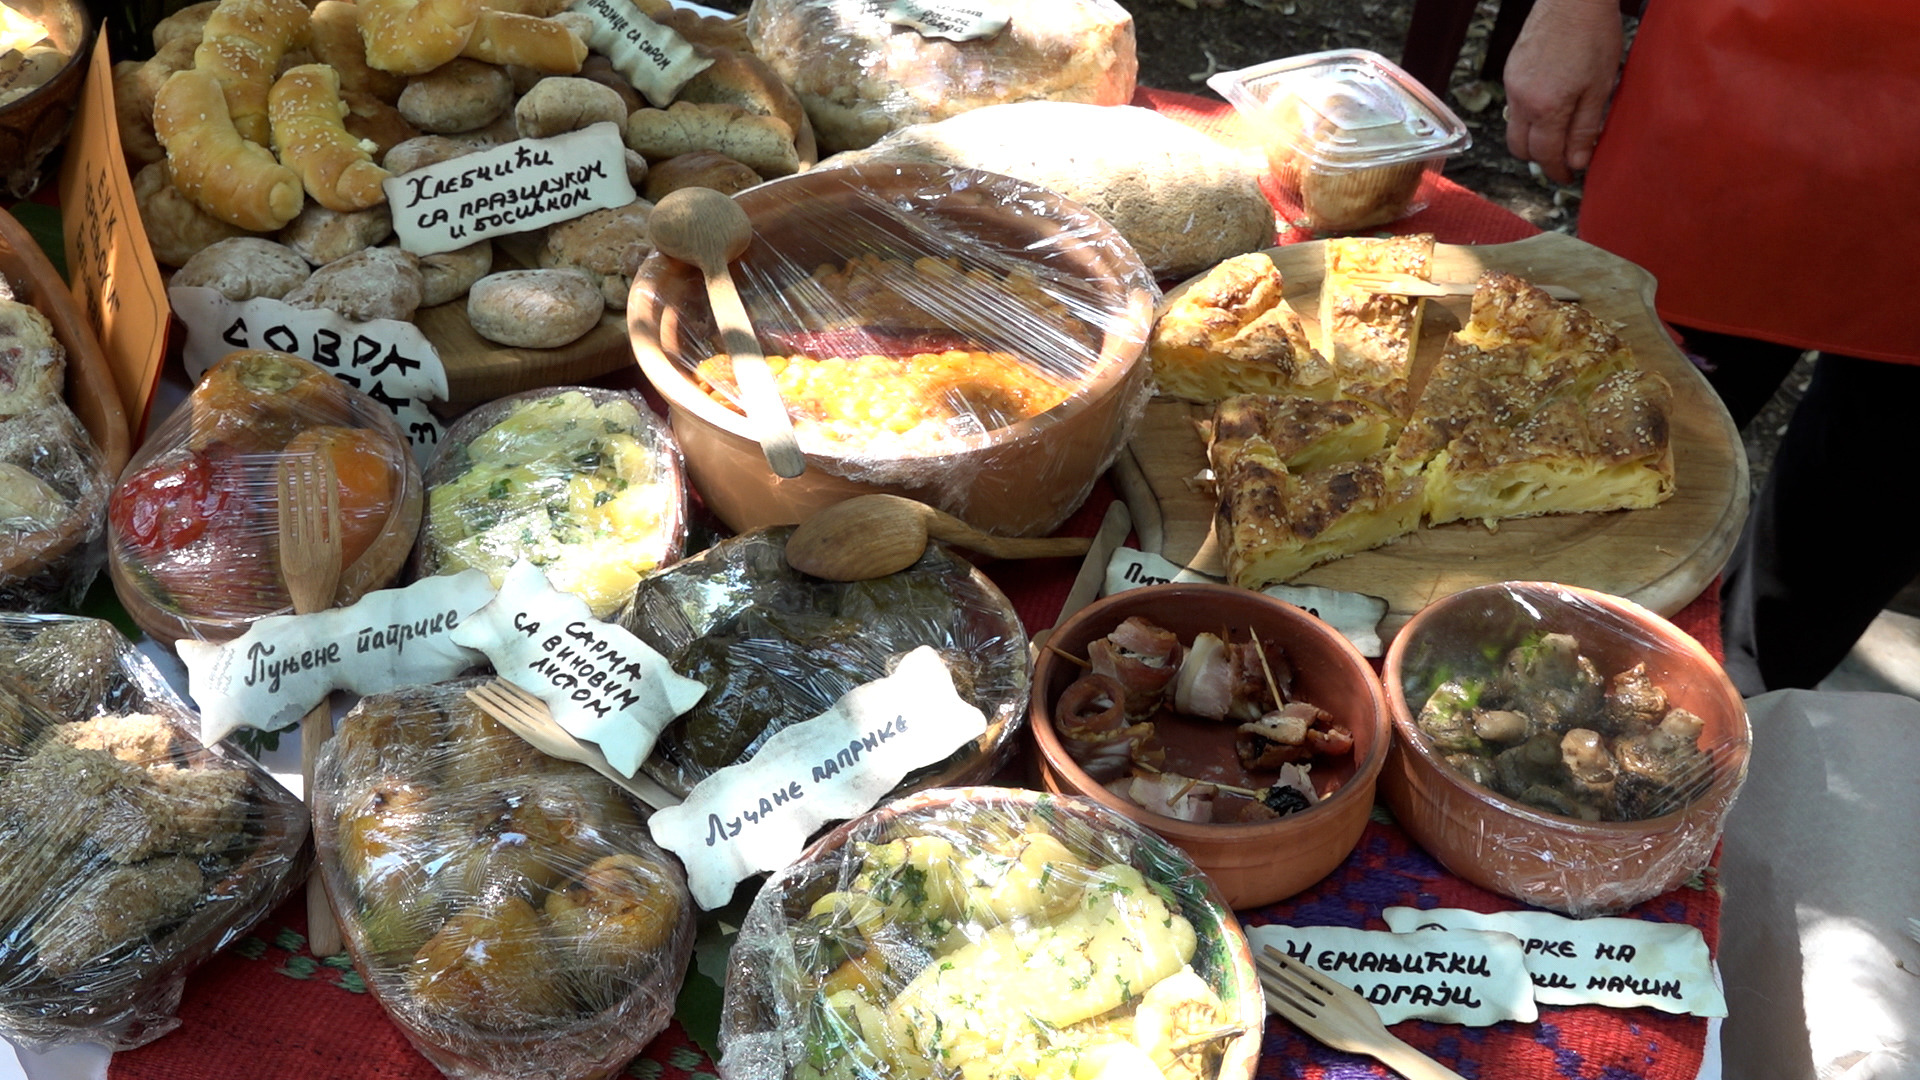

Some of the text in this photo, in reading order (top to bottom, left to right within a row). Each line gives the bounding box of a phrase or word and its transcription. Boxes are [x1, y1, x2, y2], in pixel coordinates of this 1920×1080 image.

[626, 29, 642, 44] СА
[417, 160, 607, 229] СА ПРАЗИЛУКОМ
[449, 224, 467, 239] И
[514, 612, 640, 711] СА ВИНОВИМ
[565, 621, 642, 682] САРМА
[529, 657, 611, 718] ЛИСТОМ
[1595, 942, 1637, 963] НА
[1586, 974, 1683, 1000] НАЧИН
